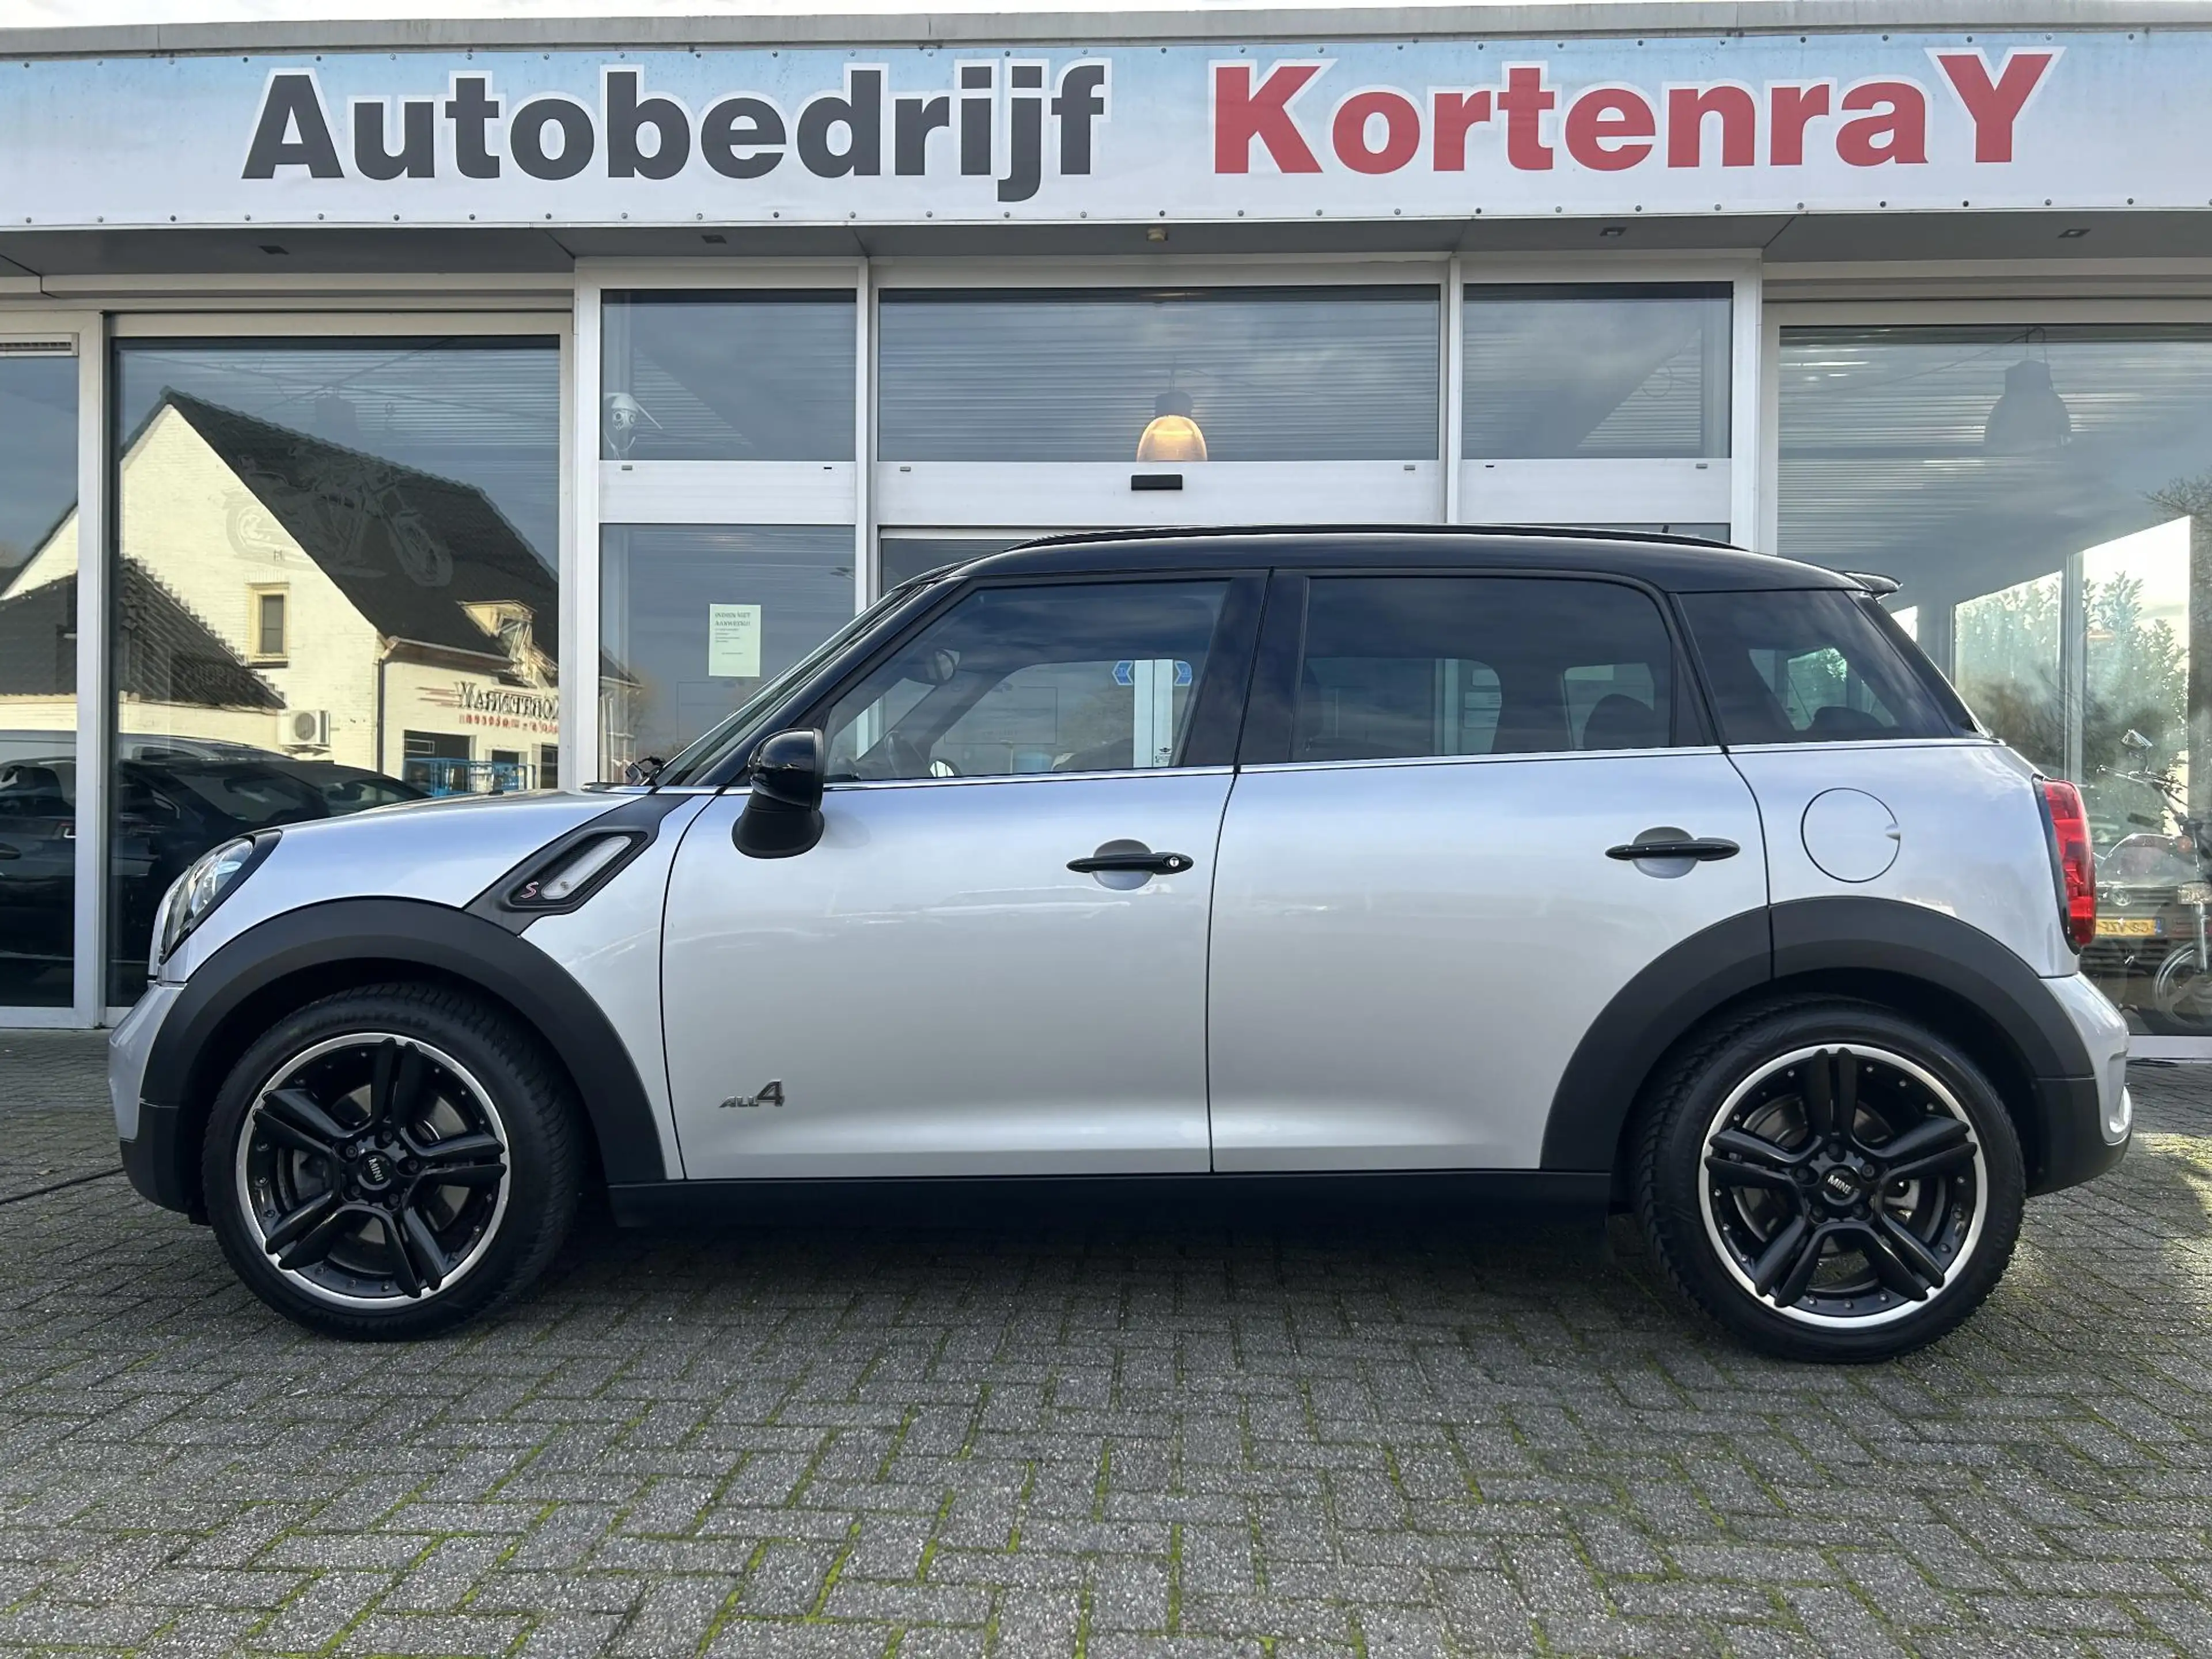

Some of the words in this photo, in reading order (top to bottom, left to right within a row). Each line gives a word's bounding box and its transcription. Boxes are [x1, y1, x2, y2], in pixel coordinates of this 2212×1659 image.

[241, 65, 1105, 202] Autobedrijf
[1215, 54, 2052, 175] KortenraY
[520, 881, 540, 899] S
[718, 1079, 785, 1108] ALL4
[369, 1157, 384, 1182] MINI
[1827, 1175, 1852, 1195] MINI
